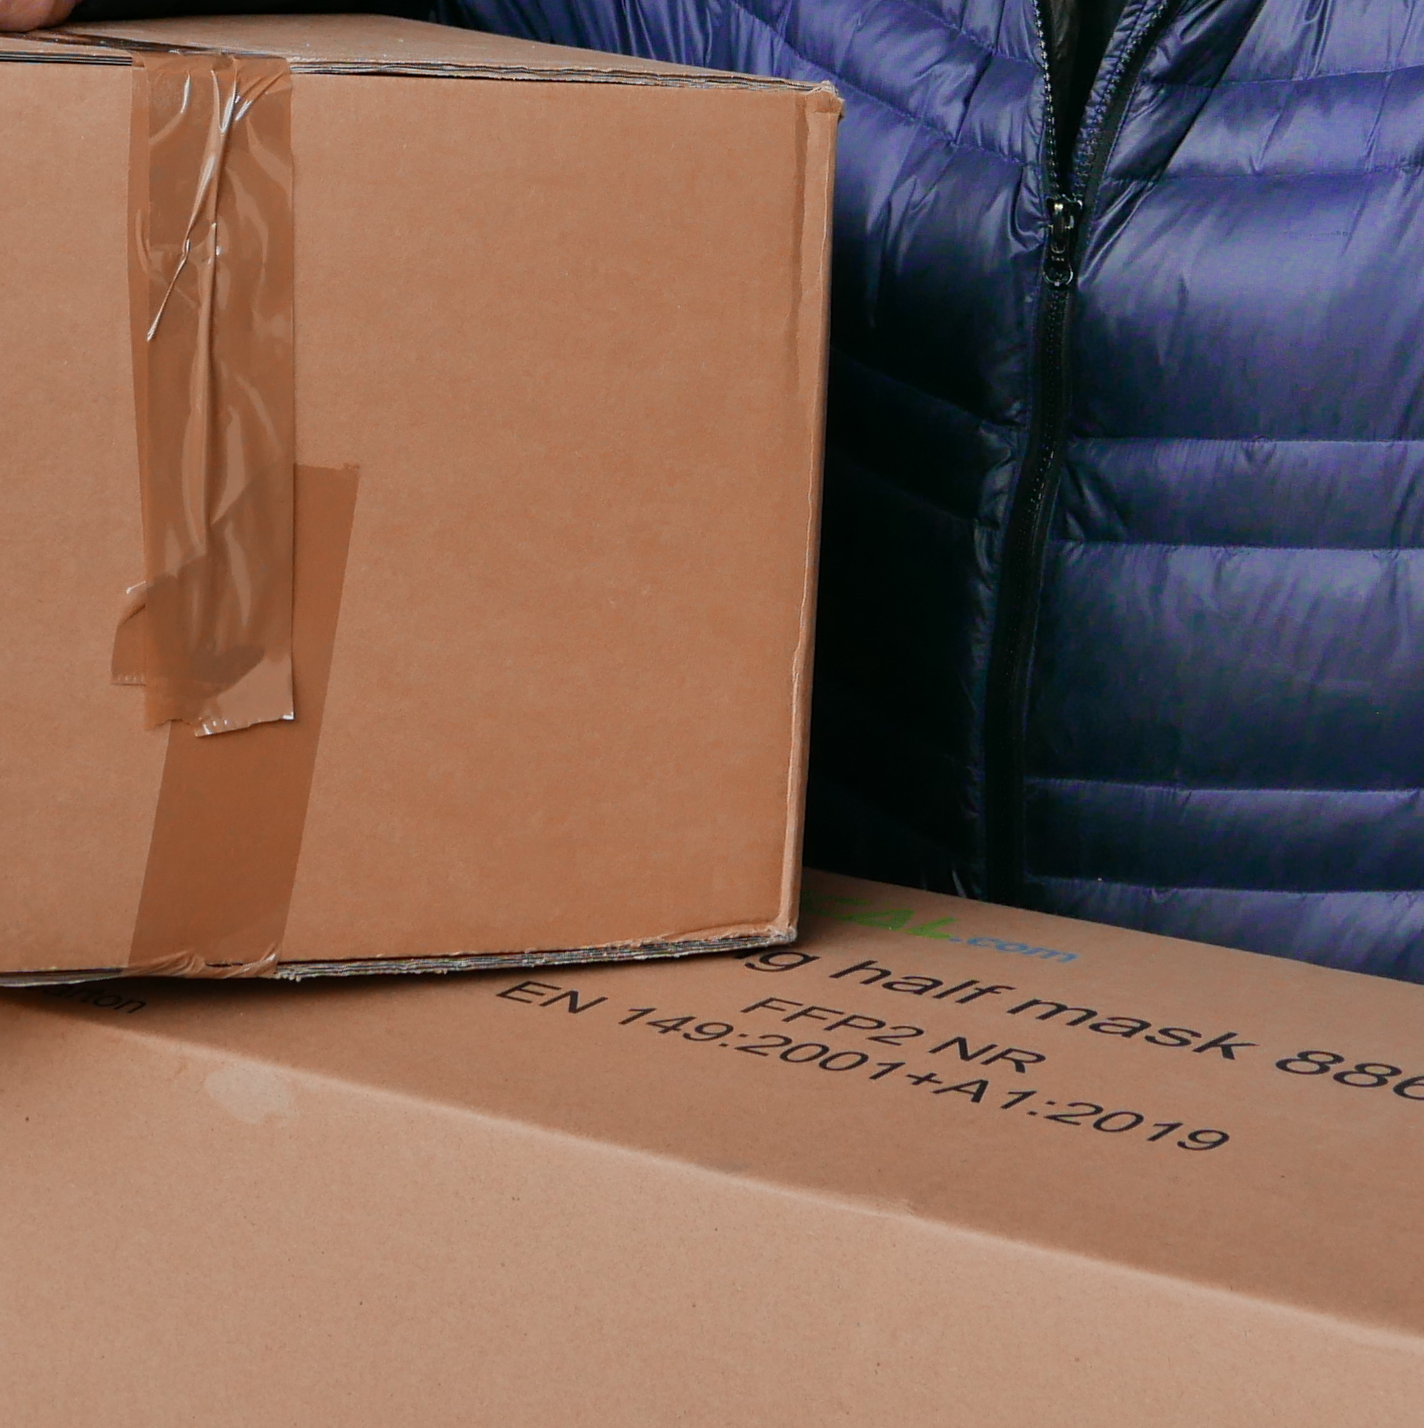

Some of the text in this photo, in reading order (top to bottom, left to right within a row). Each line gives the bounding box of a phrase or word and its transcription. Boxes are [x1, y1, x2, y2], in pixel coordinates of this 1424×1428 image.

[740, 997, 1047, 1073] FFP2 NR
[829, 960, 1017, 1005] half
[1006, 998, 1260, 1061] mask
[495, 980, 1231, 1151] EN 149:2001+A1:2019
